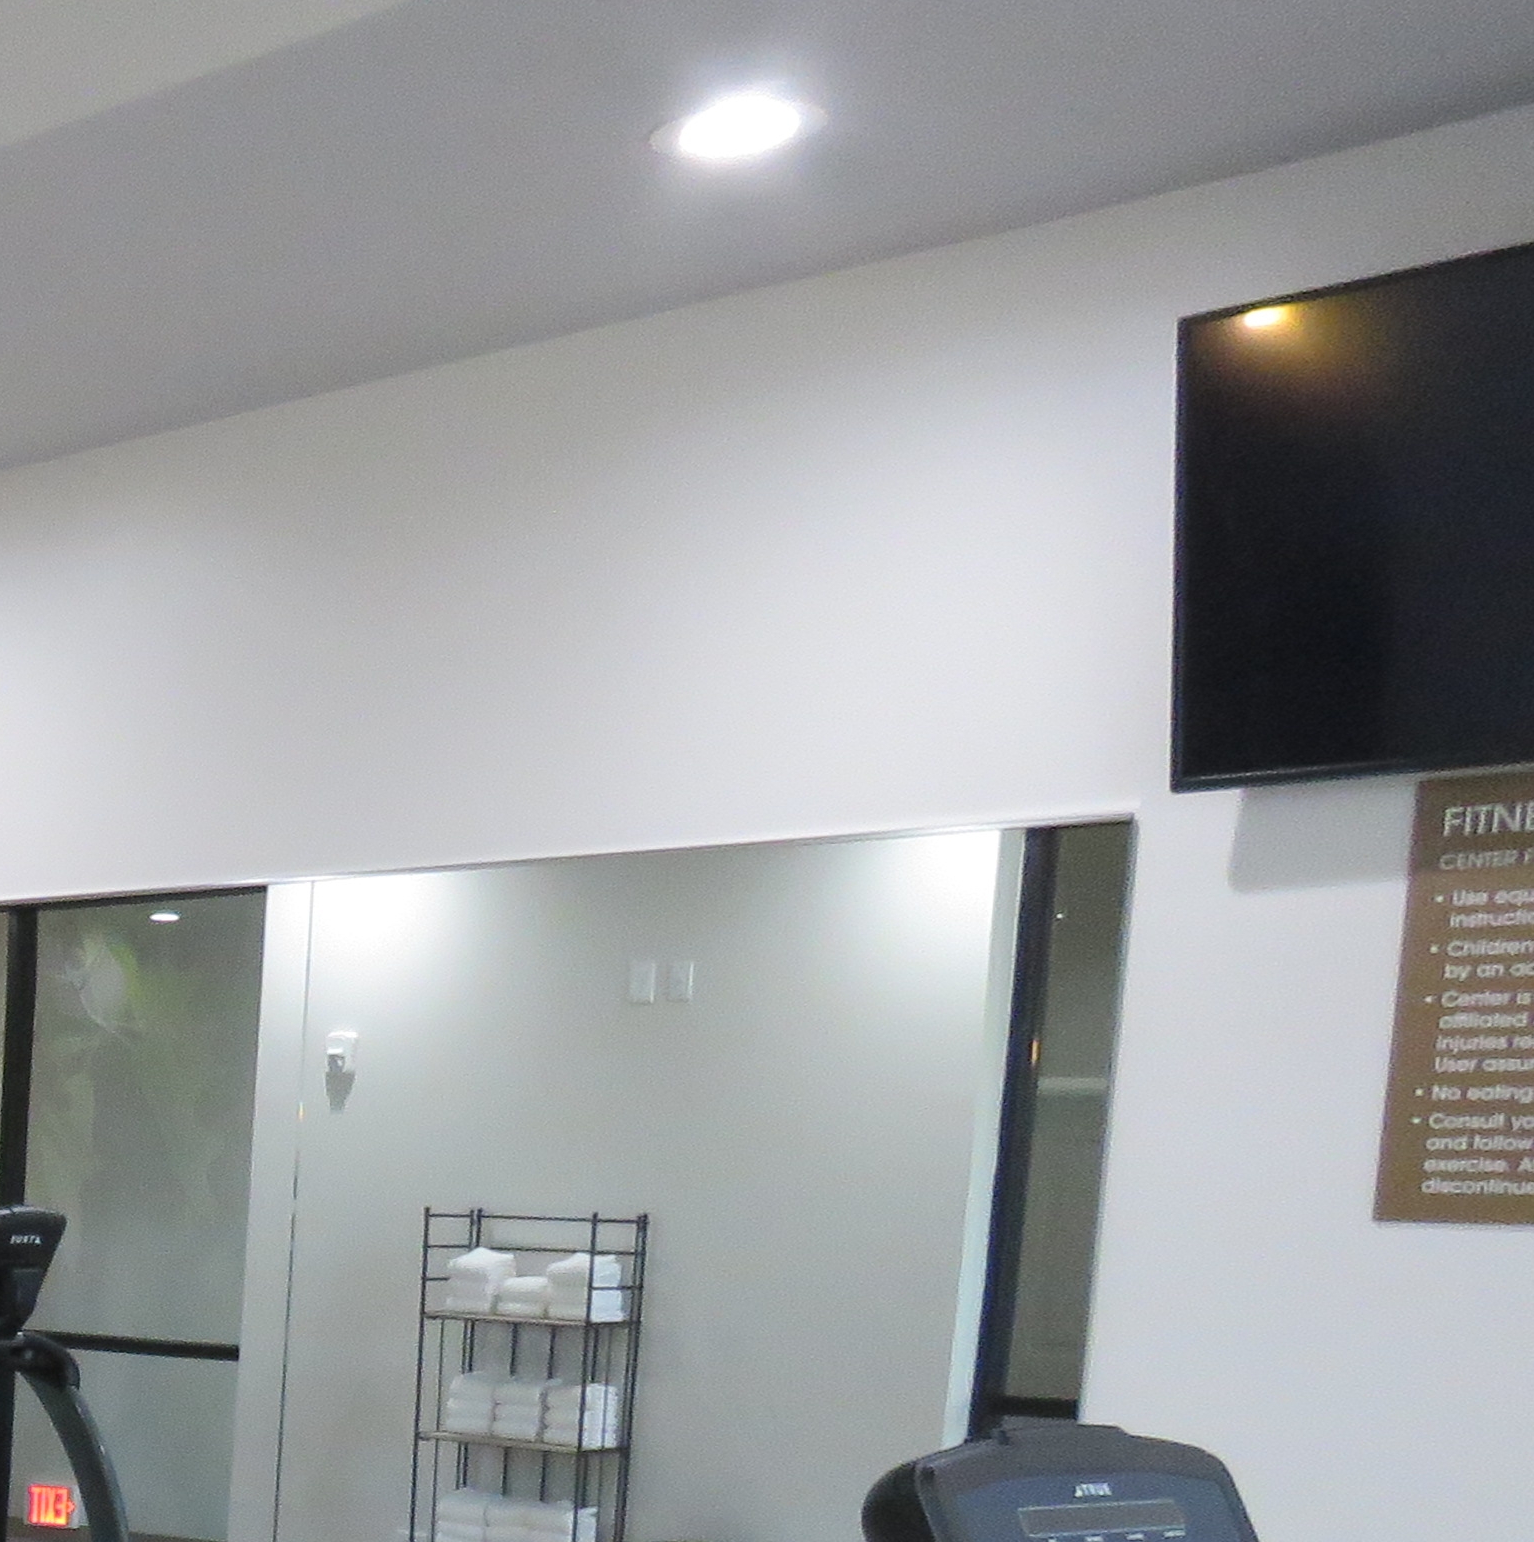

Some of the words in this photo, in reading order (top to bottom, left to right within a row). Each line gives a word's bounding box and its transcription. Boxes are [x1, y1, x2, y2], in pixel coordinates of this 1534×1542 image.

[1439, 849, 1517, 870] CENTER
[1453, 889, 1488, 907] Use
[1443, 963, 1472, 982] by
[1476, 963, 1504, 978] an
[1441, 990, 1509, 1008] Center
[1439, 1011, 1528, 1029] affiliated
[1435, 1034, 1507, 1055] injuries
[1435, 1056, 1477, 1074] User
[1432, 1085, 1461, 1101] No
[1429, 1112, 1505, 1130] Consult
[1426, 1134, 1468, 1152] and
